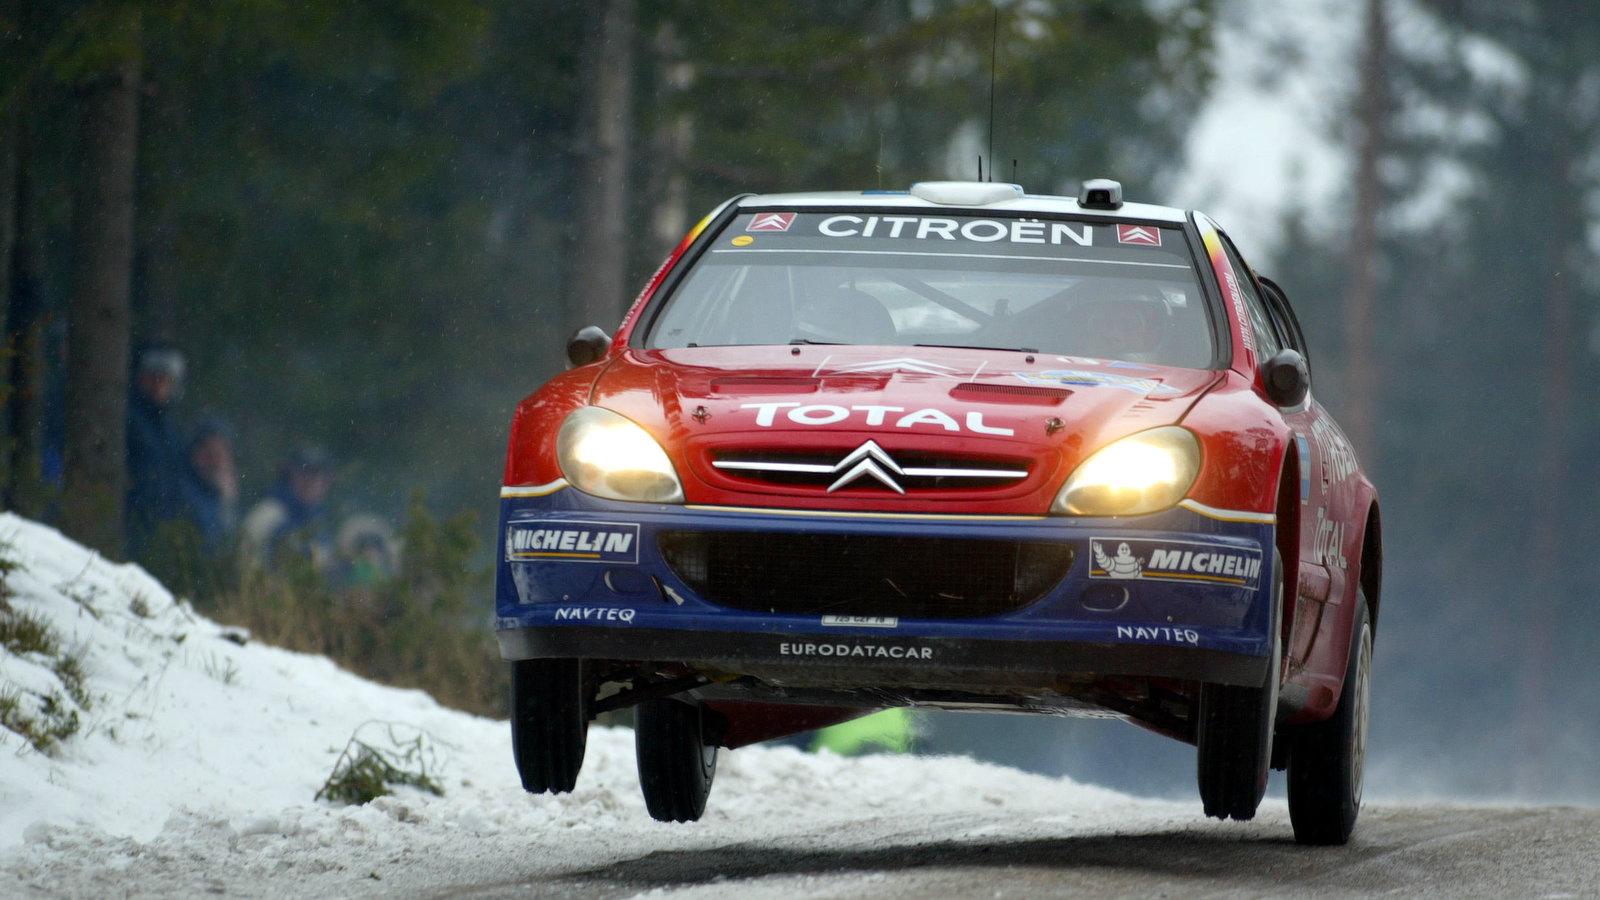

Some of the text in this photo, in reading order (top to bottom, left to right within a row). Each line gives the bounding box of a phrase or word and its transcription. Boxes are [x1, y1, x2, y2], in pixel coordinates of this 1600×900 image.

[818, 214, 1094, 247] CITROËN
[741, 402, 1014, 436] TOTAL
[514, 530, 633, 553] MICHELIN
[1148, 549, 1262, 579] MICHELIN
[555, 607, 636, 624] NAVTEQ
[1117, 625, 1199, 646] NAVTEQ
[780, 643, 933, 660] EURODATACAR
